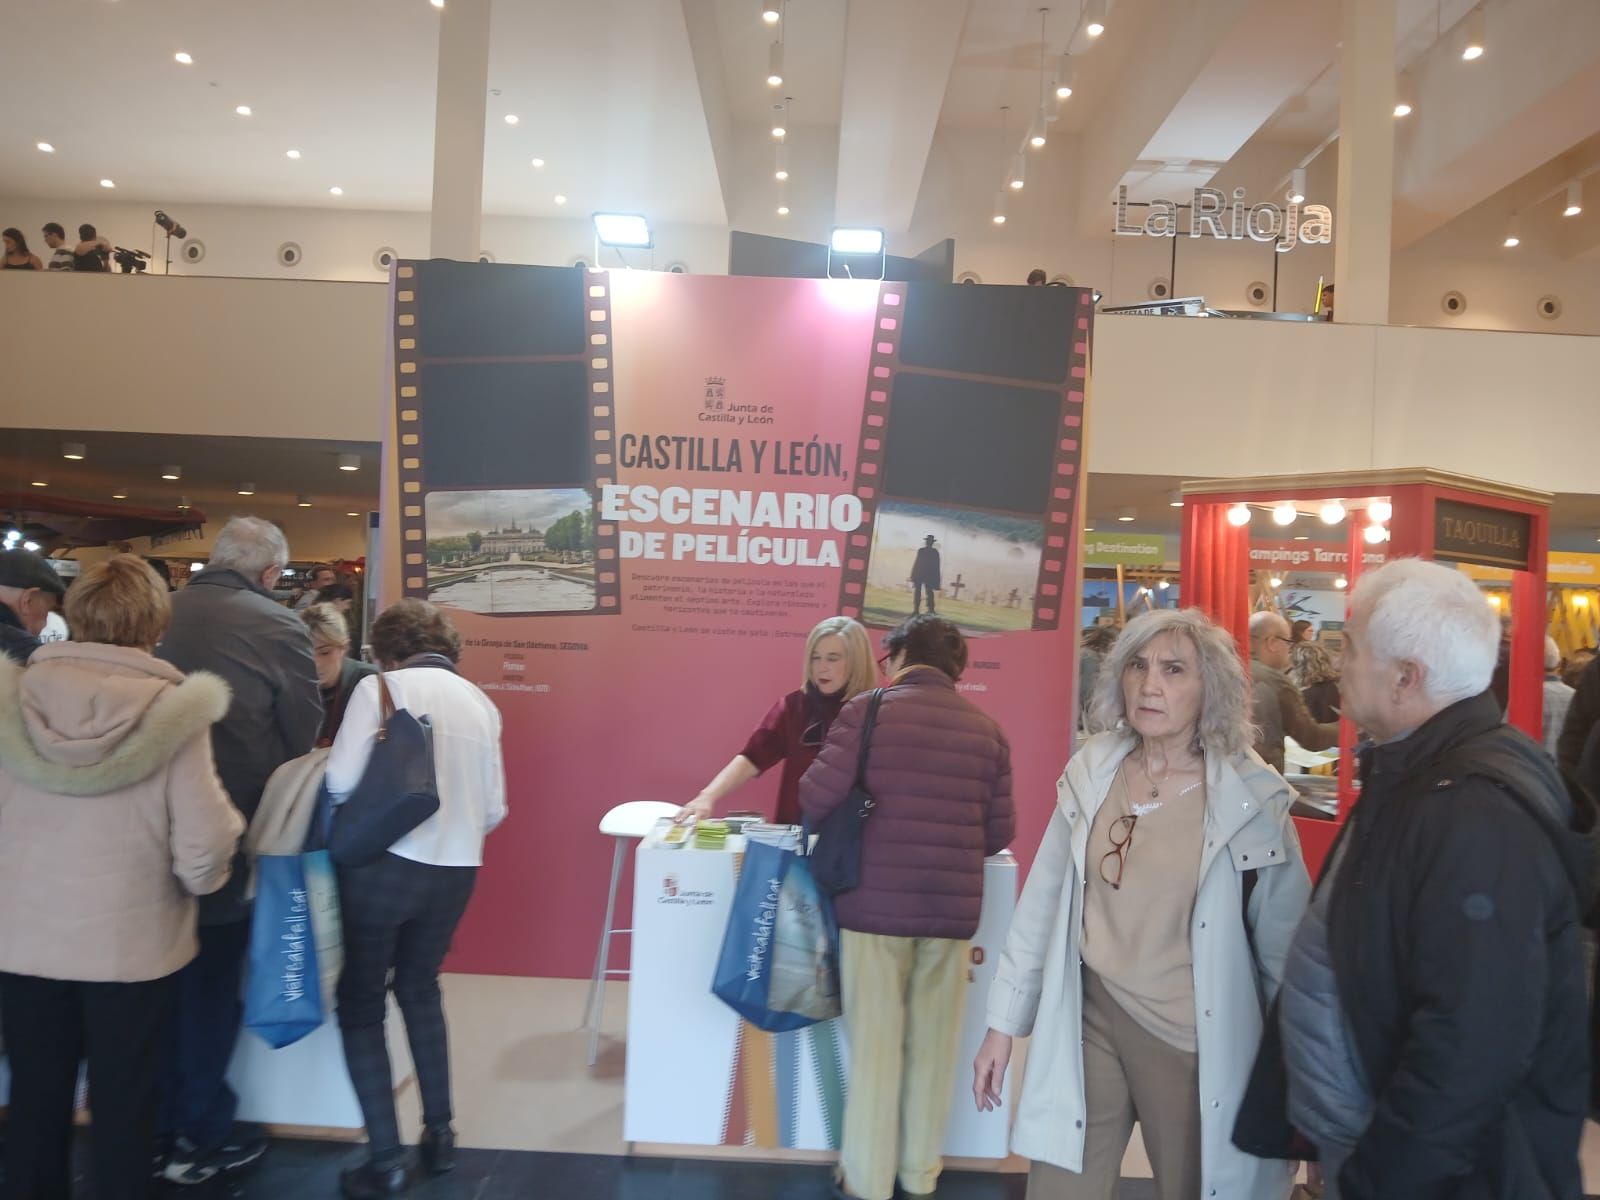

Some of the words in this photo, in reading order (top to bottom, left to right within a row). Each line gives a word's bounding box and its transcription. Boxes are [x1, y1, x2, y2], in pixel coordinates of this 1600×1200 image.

[1115, 185, 1177, 237] La
[1189, 187, 1333, 253] Rioja
[698, 412, 736, 423] Castilla
[737, 415, 745, 426] y
[747, 413, 775, 424] León
[727, 403, 758, 413] Junta
[760, 404, 775, 414] de
[619, 433, 742, 473] CASTILLA
[750, 439, 768, 474] Y
[773, 433, 849, 481] LEÓN,
[601, 484, 864, 532] ESCENARIO
[619, 531, 666, 560] DE
[671, 528, 841, 567] PELÍCULA
[1443, 517, 1520, 548] TAQUILLA
[1248, 547, 1310, 564] ampings
